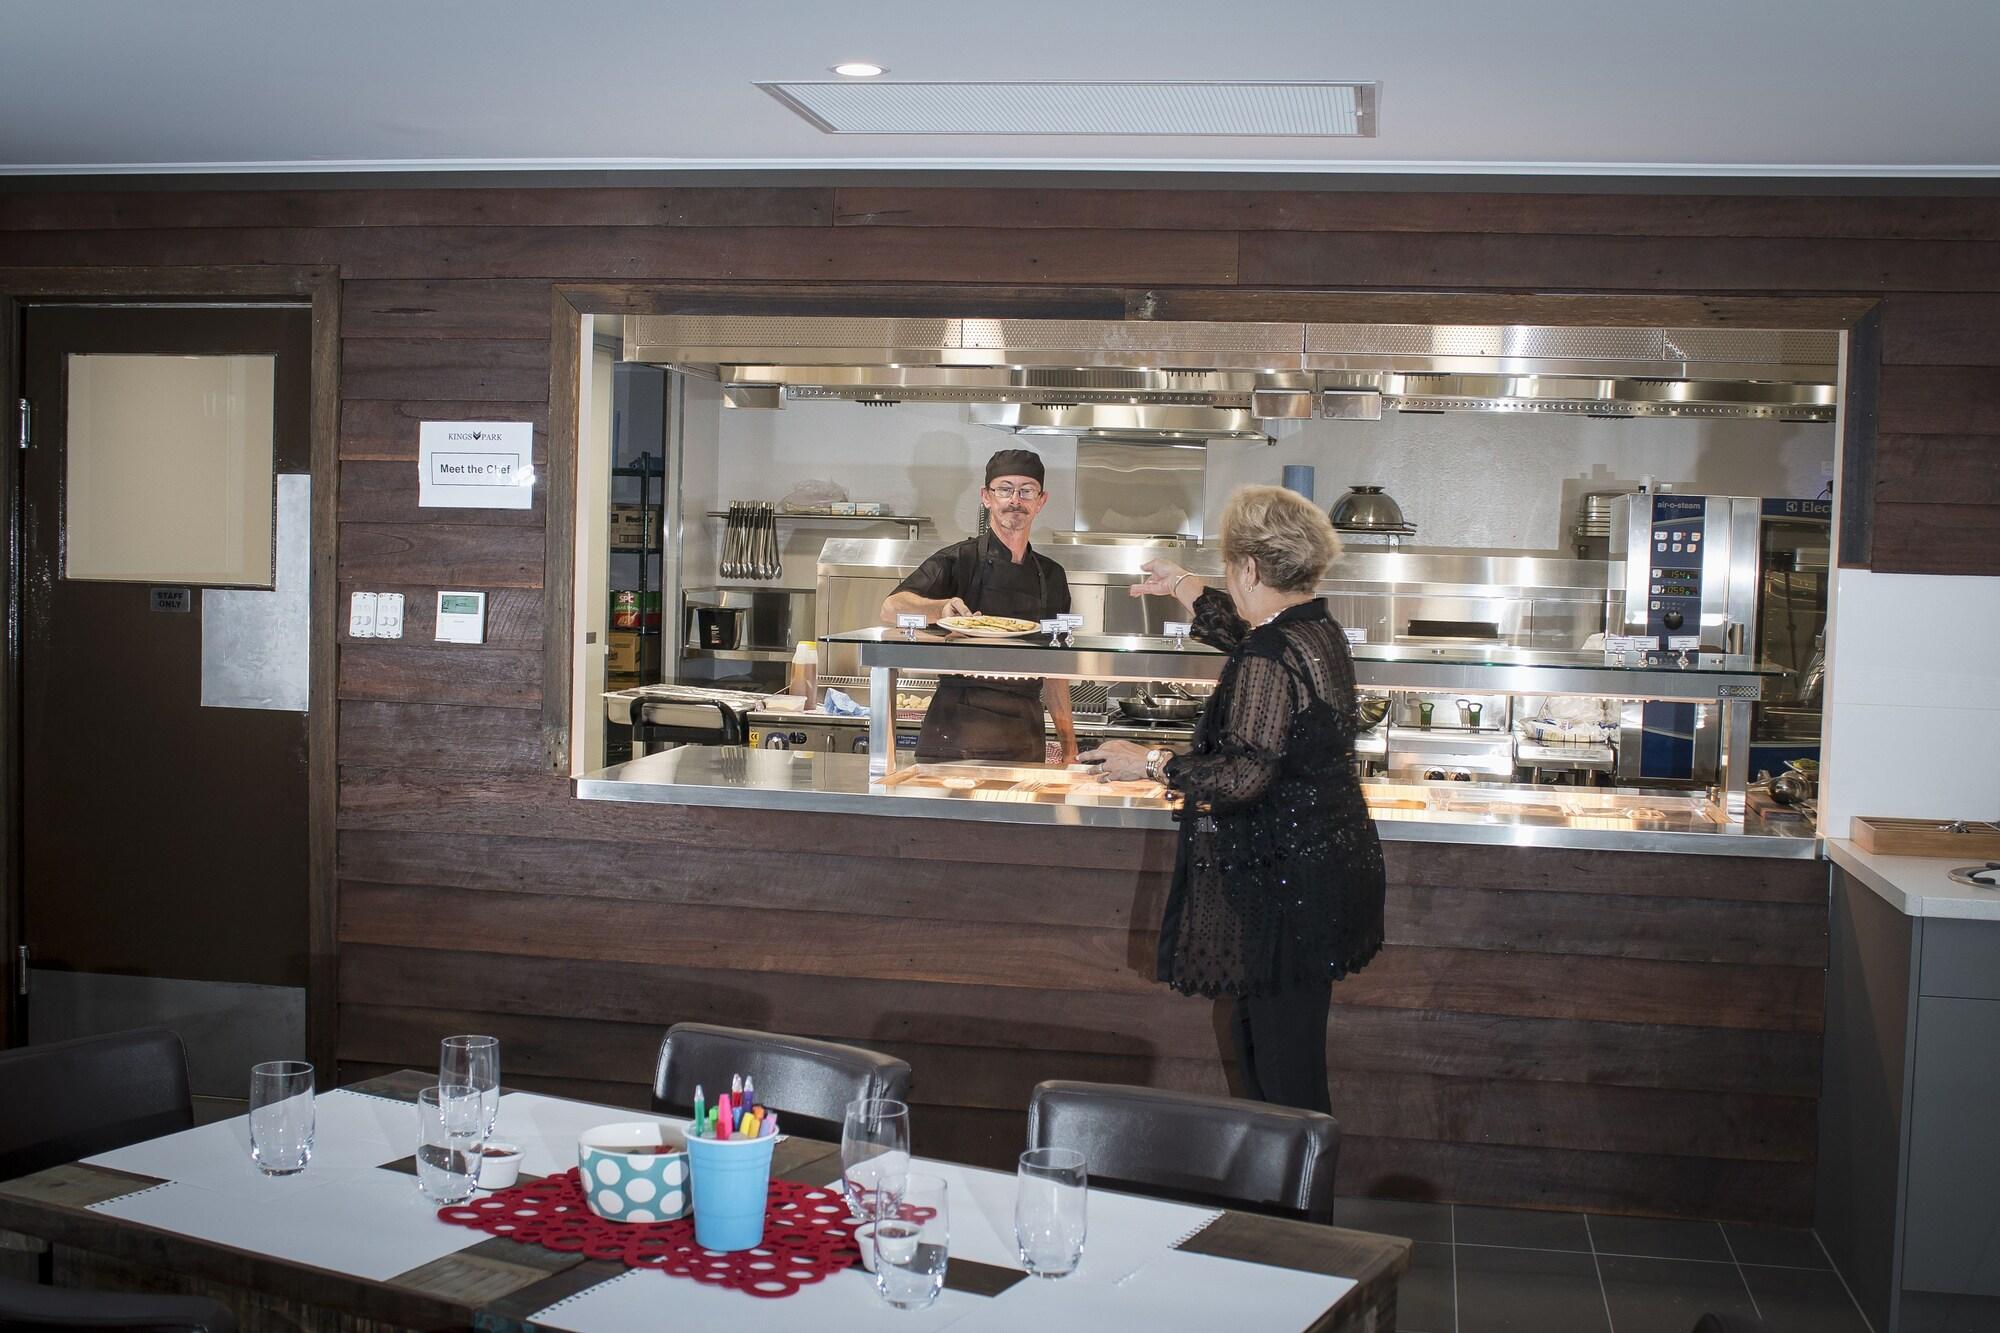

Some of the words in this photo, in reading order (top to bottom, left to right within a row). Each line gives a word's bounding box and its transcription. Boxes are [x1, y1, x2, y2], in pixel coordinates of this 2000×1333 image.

[448, 433, 473, 441] KINGS
[481, 433, 503, 441] PARK
[440, 464, 465, 474] Meet
[467, 465, 484, 475] the
[157, 592, 183, 600] STAFF
[159, 600, 181, 608] ONLY
